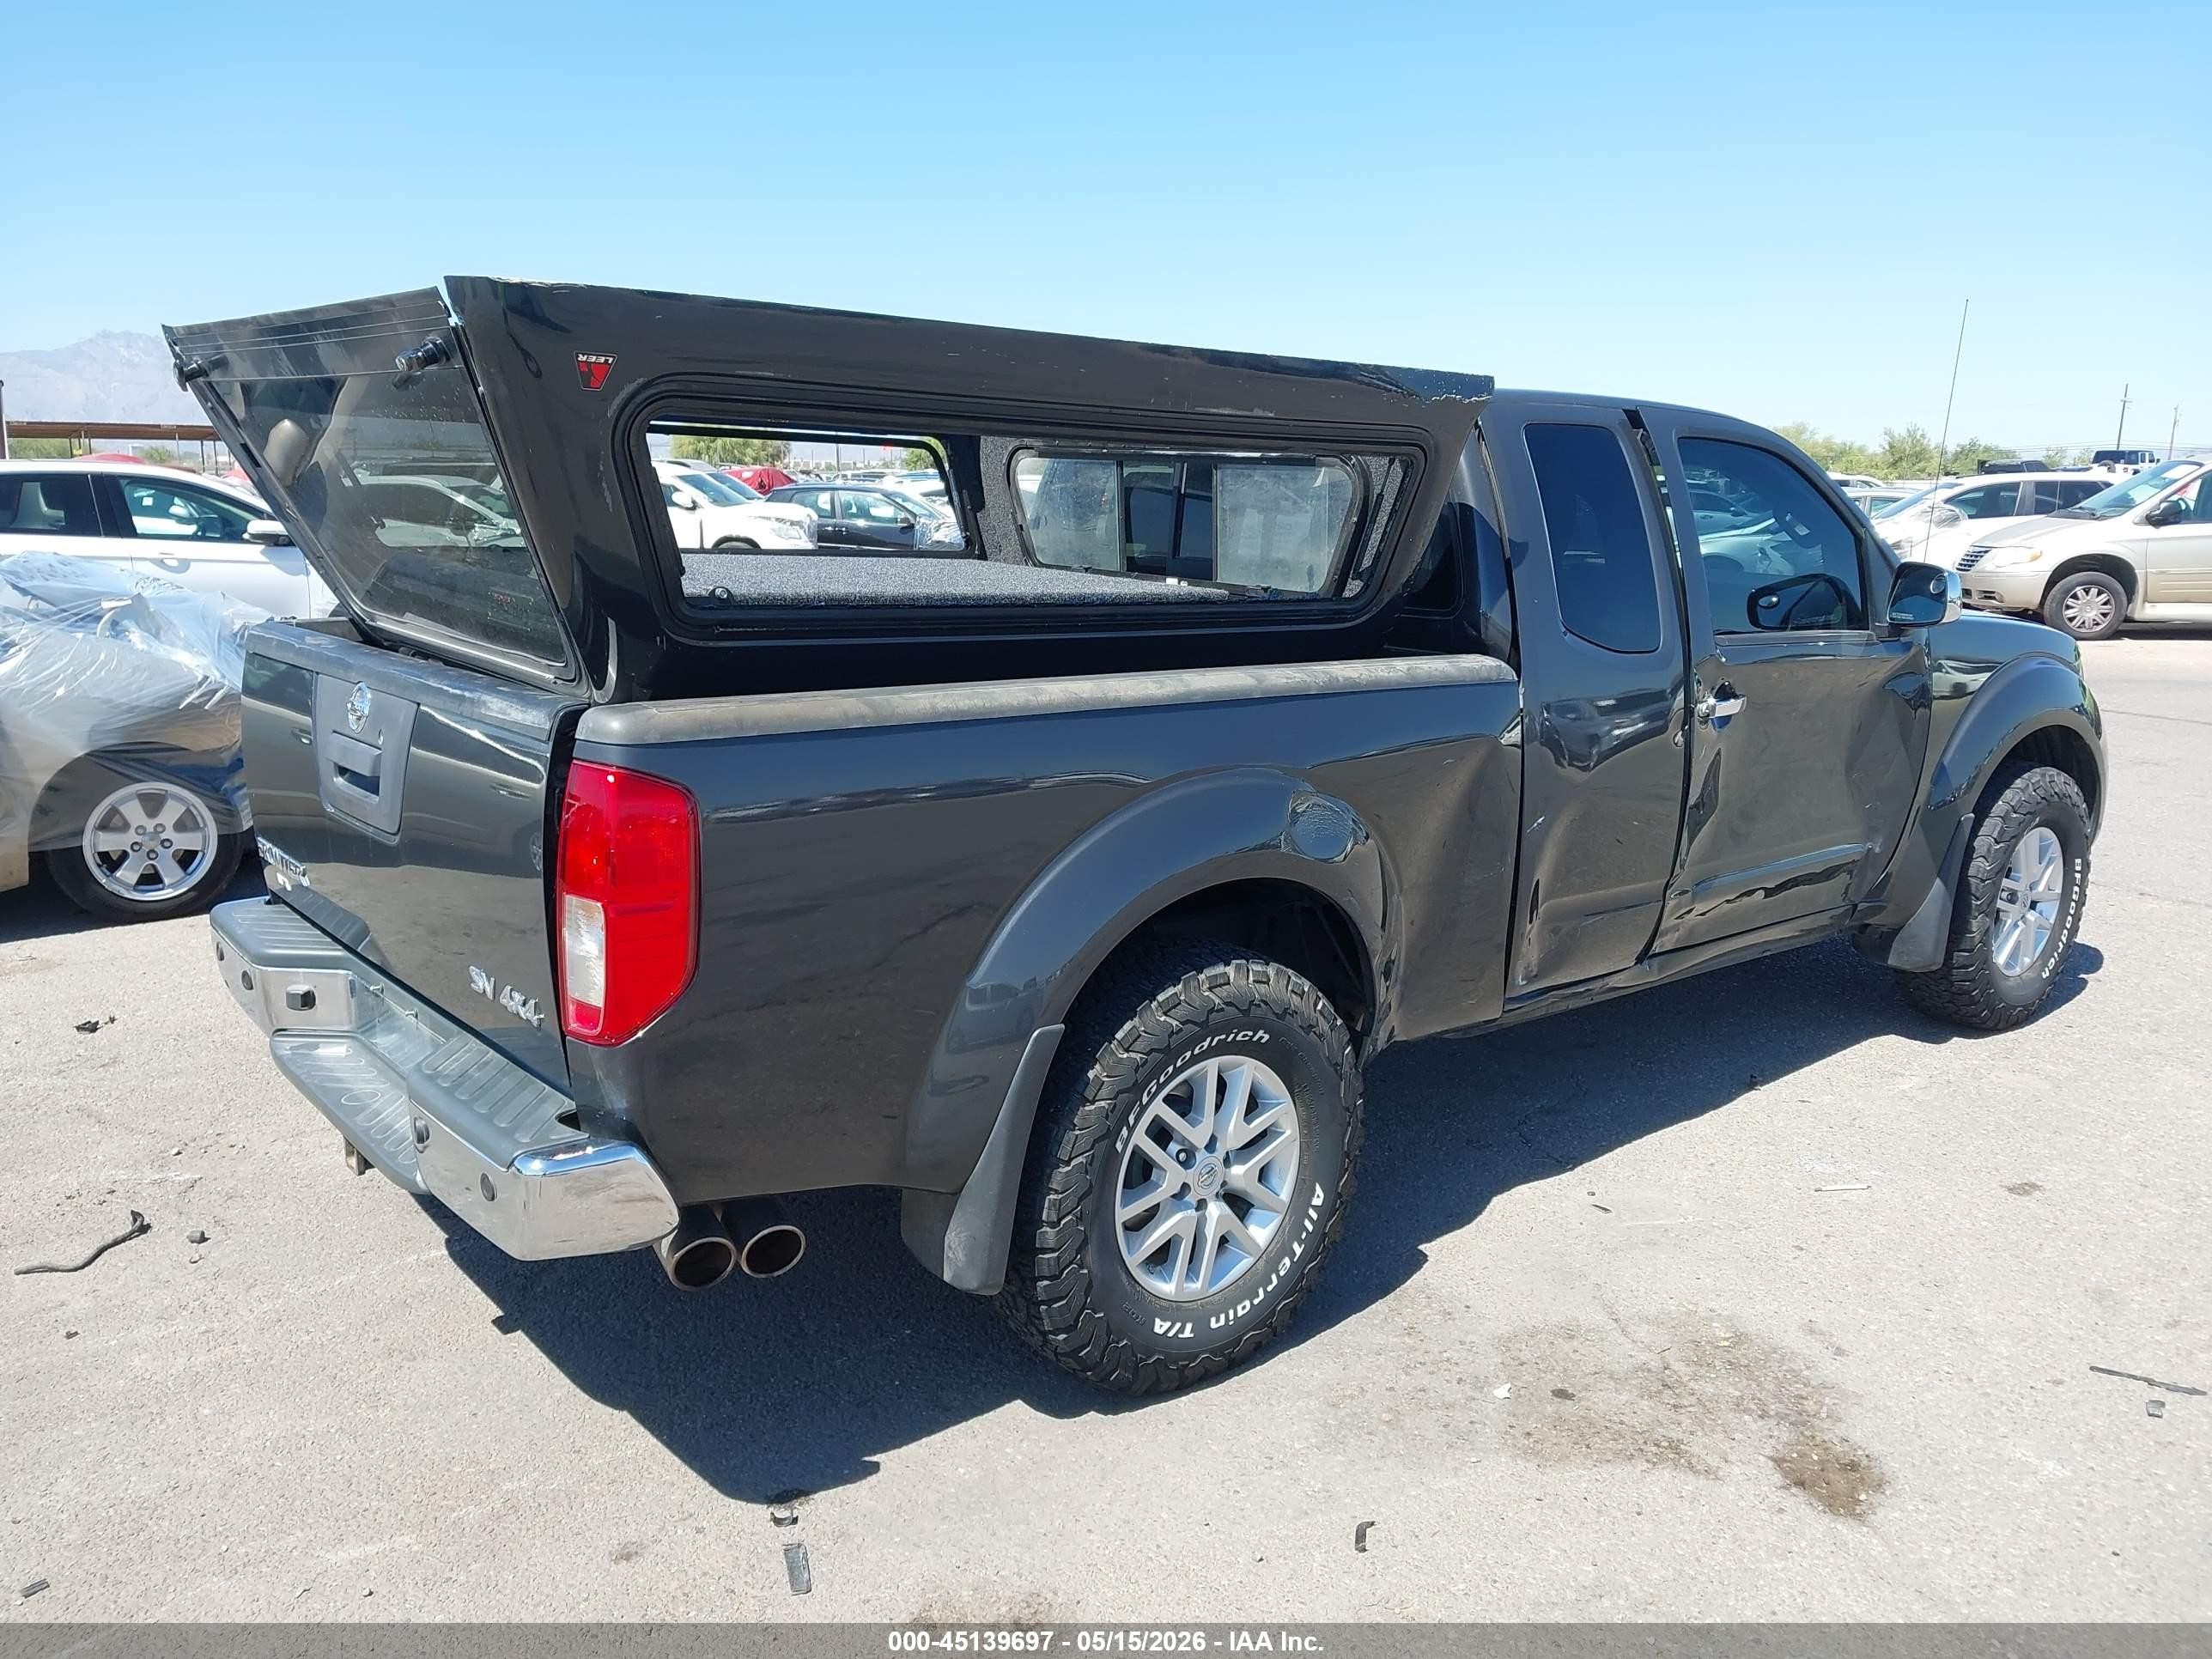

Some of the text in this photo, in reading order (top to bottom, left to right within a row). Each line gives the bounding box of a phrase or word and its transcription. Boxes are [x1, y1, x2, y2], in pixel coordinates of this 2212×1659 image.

[577, 354, 614, 363] LEER
[2041, 859, 2081, 979] BFGoodrich
[469, 965, 495, 1000] SV
[1115, 1030, 1270, 1153] BFGoodrich
[1210, 1182, 1325, 1329] All-Terrain
[1153, 1317, 1194, 1339] T/A
